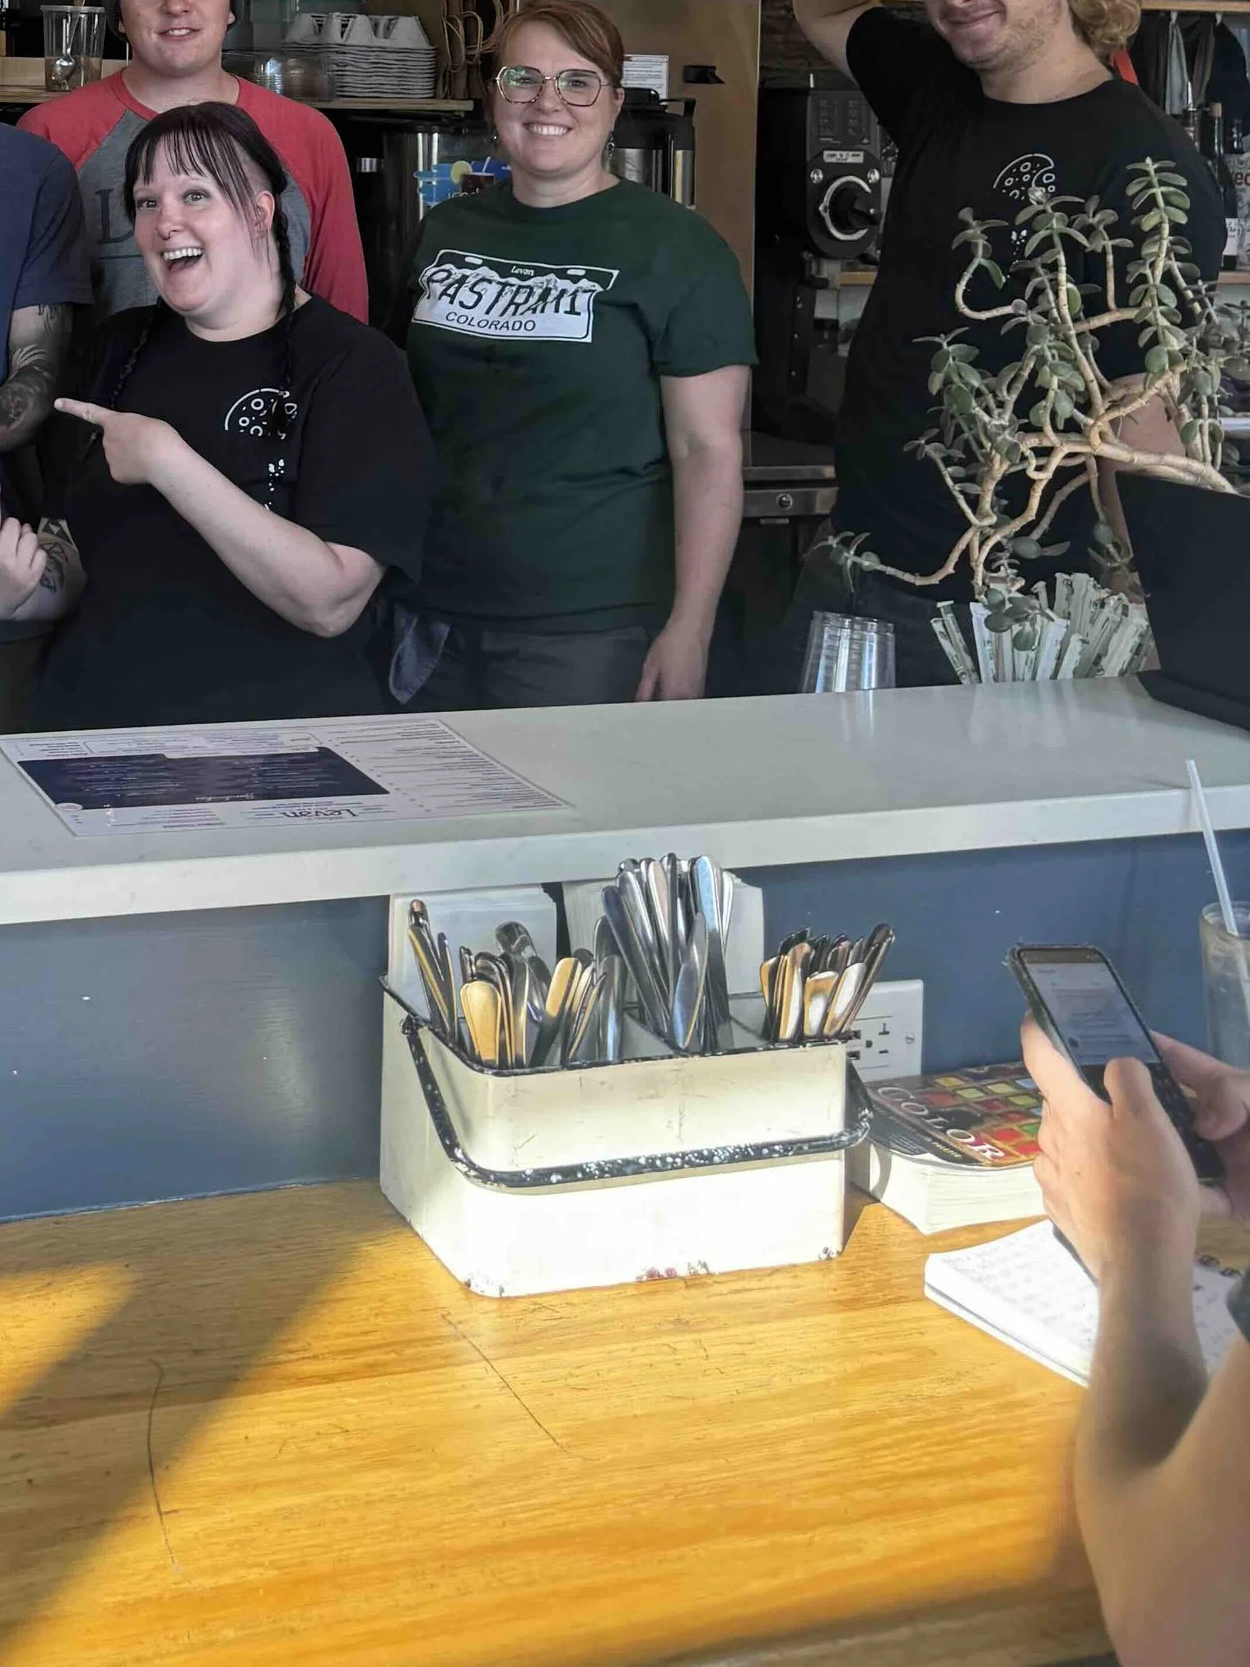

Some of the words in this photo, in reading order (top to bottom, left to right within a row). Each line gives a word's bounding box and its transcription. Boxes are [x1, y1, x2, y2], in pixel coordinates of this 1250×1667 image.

[426, 269, 596, 317] PASTRAMI
[446, 311, 536, 332] COLORADO
[878, 1087, 1005, 1158] COLOR
